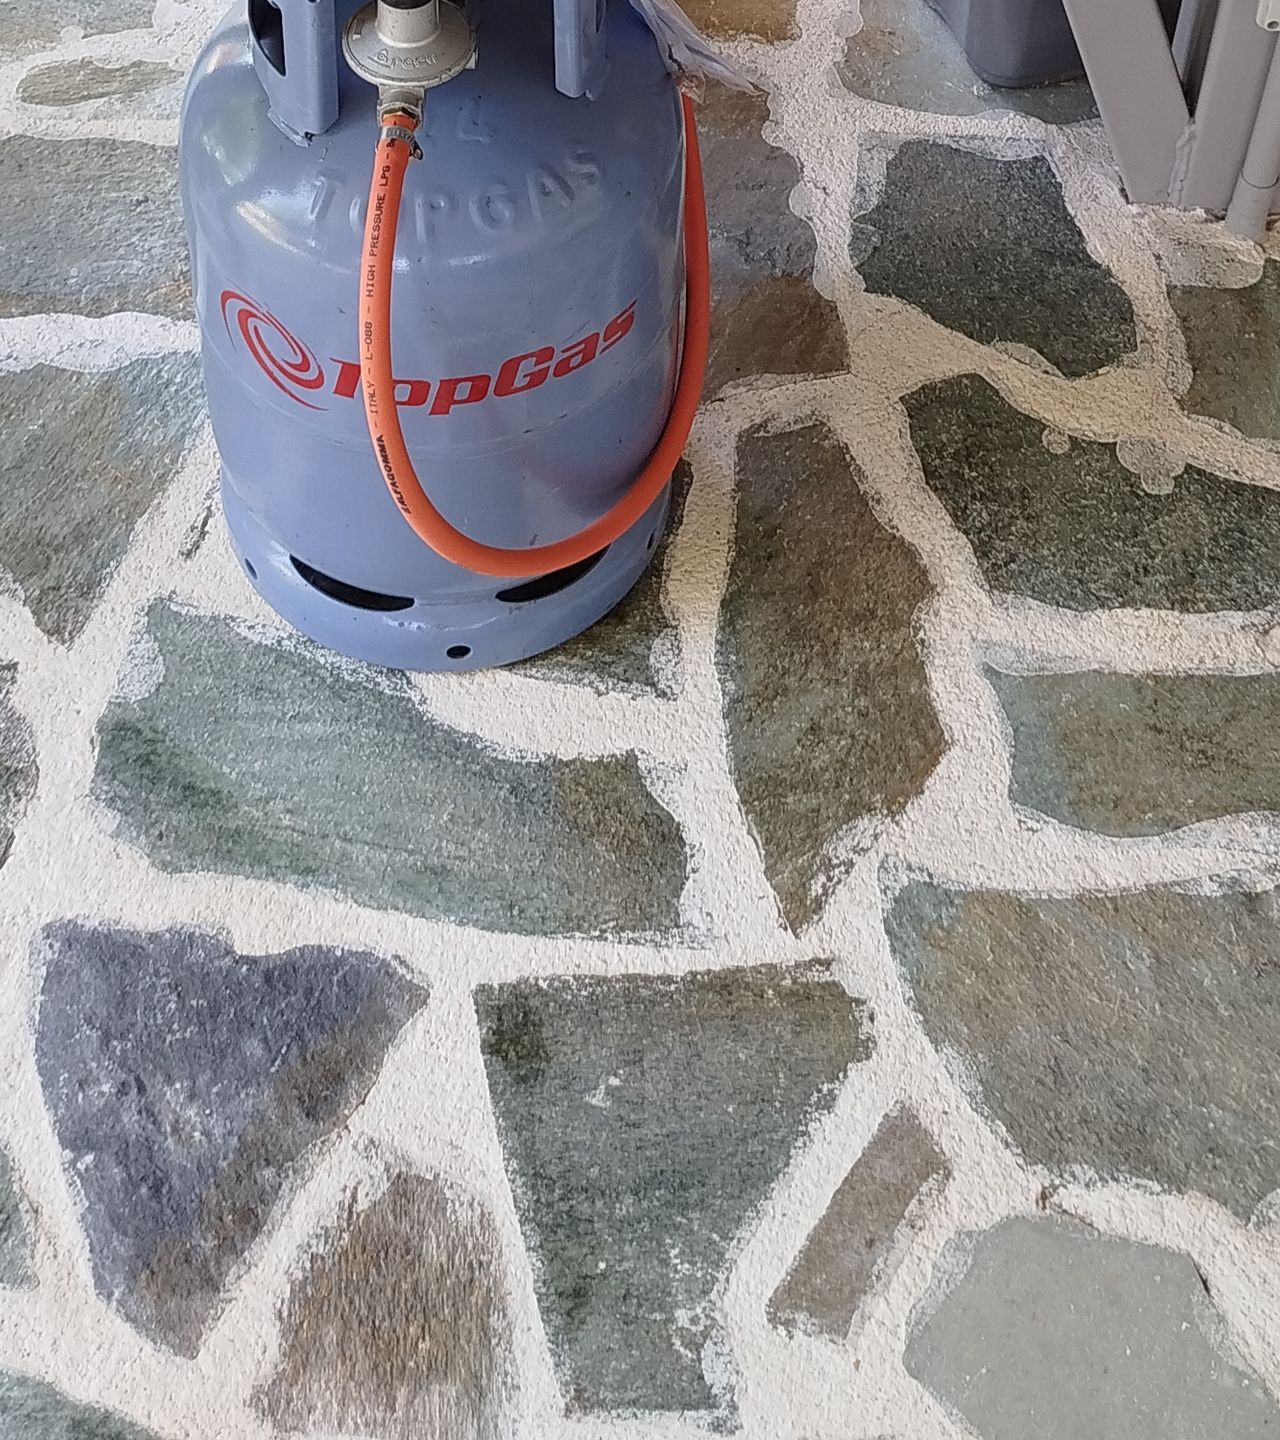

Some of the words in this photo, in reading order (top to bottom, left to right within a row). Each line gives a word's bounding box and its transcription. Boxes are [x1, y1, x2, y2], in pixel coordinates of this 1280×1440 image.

[379, 164, 391, 187] LPG
[369, 193, 386, 257] PRESSURE
[365, 264, 376, 298] HIGH
[367, 380, 379, 414] ITALY
